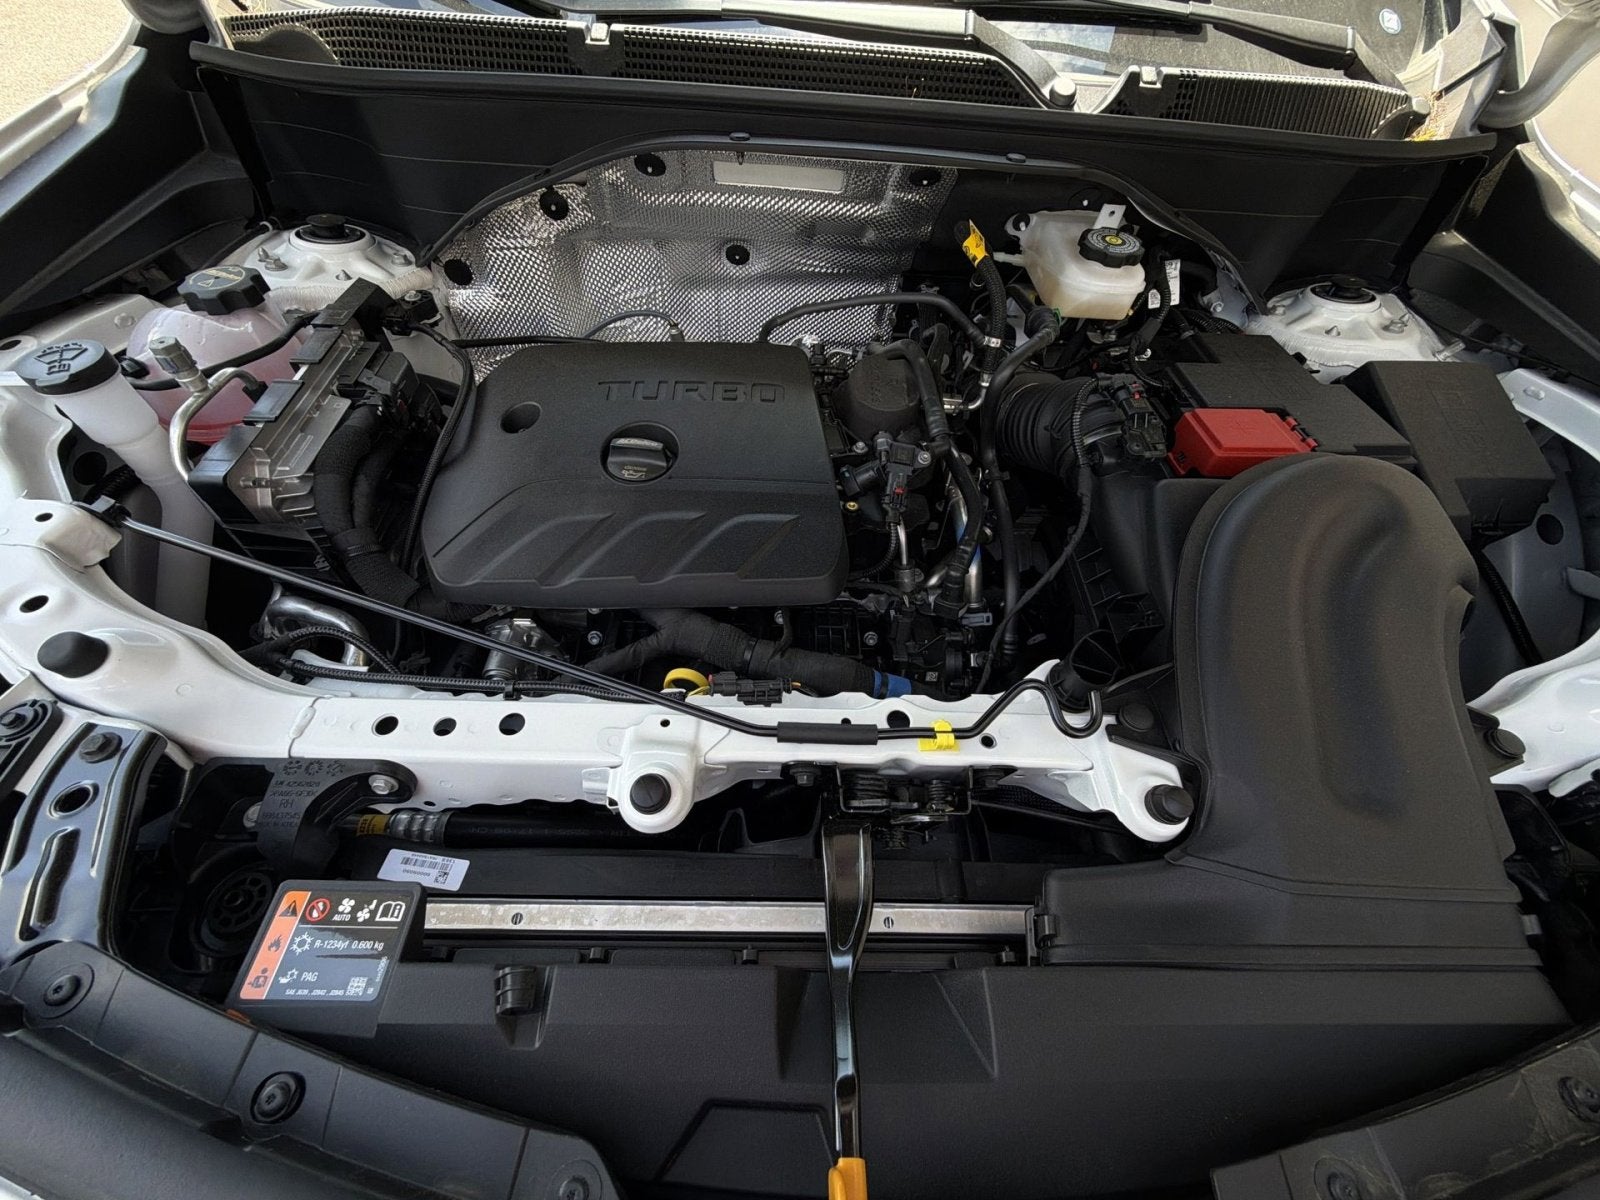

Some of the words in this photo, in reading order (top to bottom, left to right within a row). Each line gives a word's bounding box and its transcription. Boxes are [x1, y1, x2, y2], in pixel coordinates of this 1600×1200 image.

[598, 380, 785, 403] TURBO
[278, 798, 295, 808] RH
[332, 913, 352, 922] AUTO
[313, 939, 349, 951] R-1234yf
[351, 940, 373, 950] 0.600
[374, 941, 384, 951] kg
[301, 971, 319, 982] PAG
